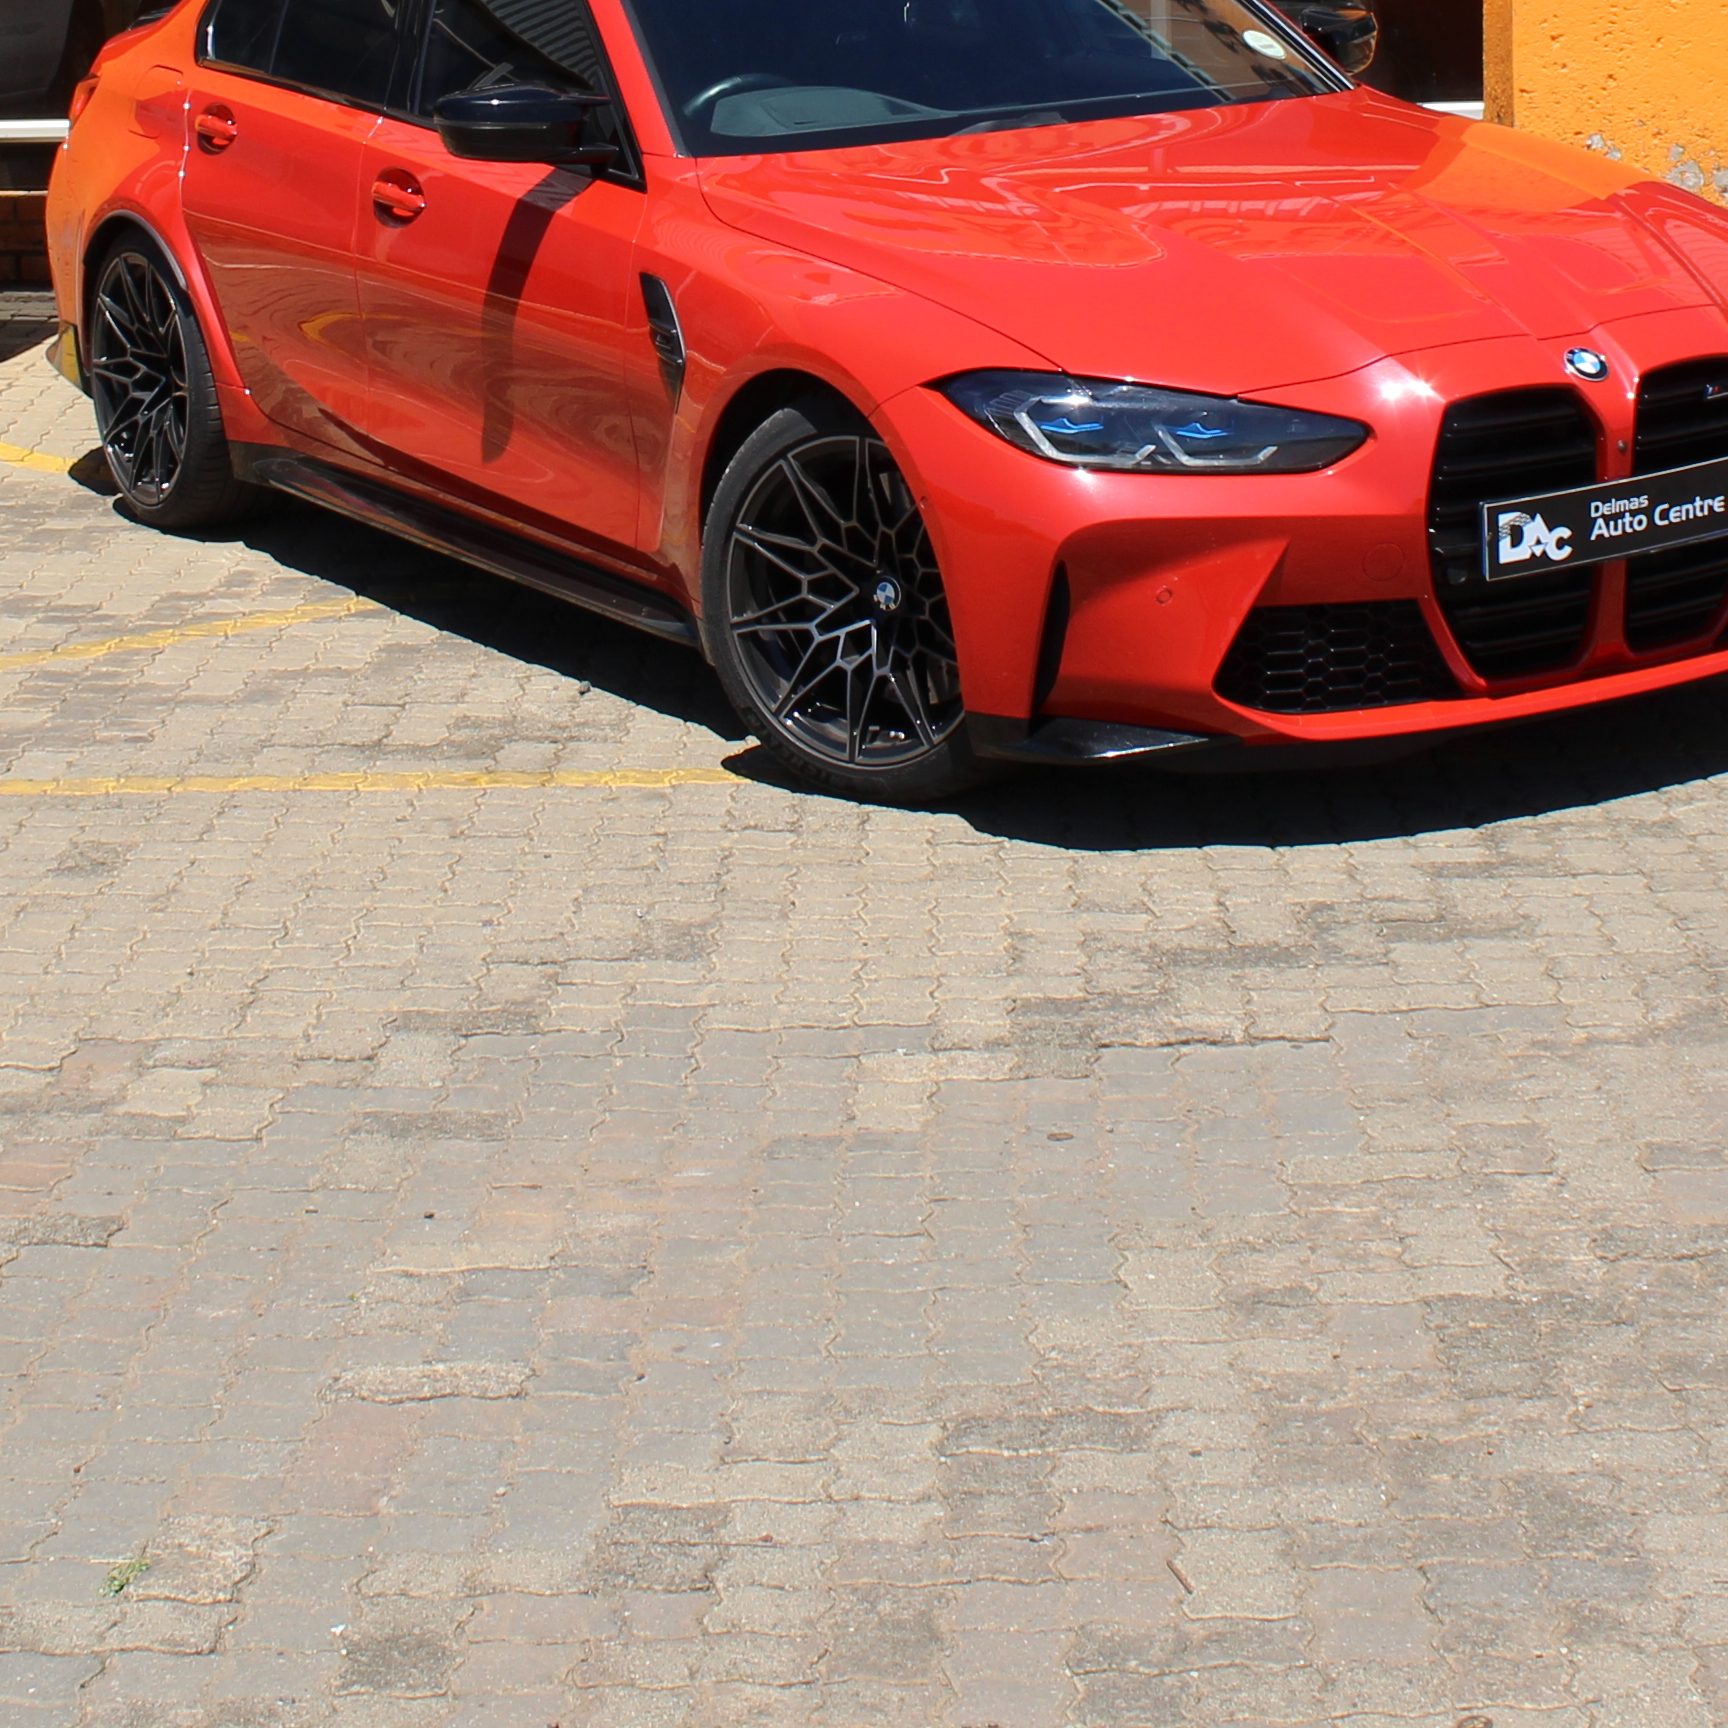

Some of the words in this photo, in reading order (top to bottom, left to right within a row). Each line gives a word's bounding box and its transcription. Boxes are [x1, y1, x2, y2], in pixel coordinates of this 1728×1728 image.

[1590, 495, 1649, 518] Delmas
[1590, 512, 1648, 541] Auto
[1654, 495, 1726, 527] Centre
